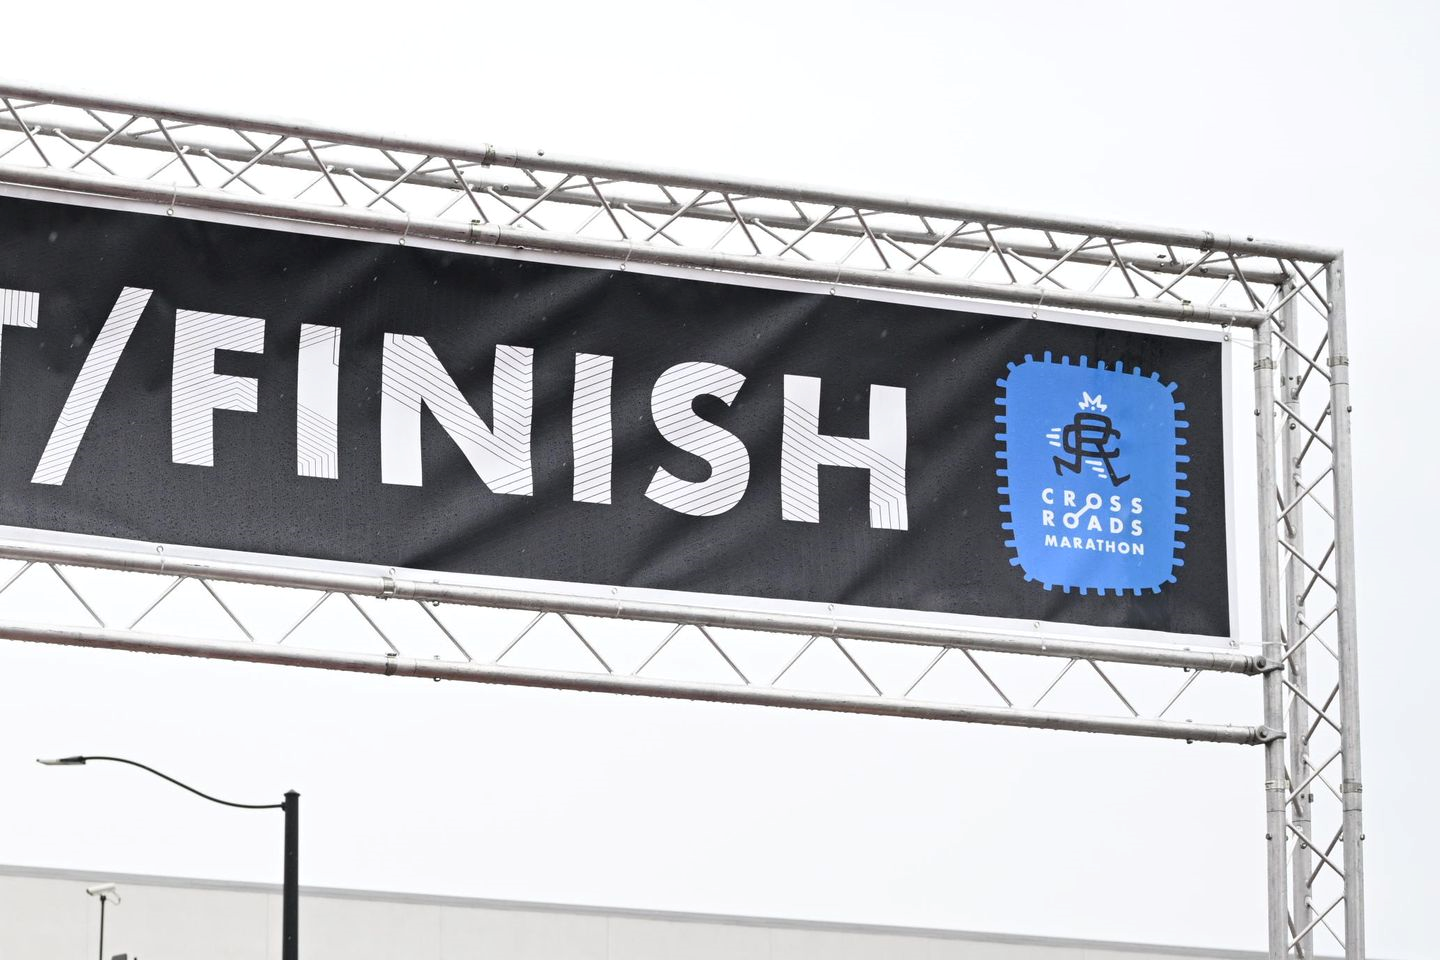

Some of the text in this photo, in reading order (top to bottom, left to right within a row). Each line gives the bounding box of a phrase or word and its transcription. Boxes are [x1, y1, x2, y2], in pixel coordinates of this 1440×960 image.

[1041, 488, 1143, 514] CROSS
[1042, 510, 1143, 537] ROADS
[1044, 534, 1145, 556] MARATHON
